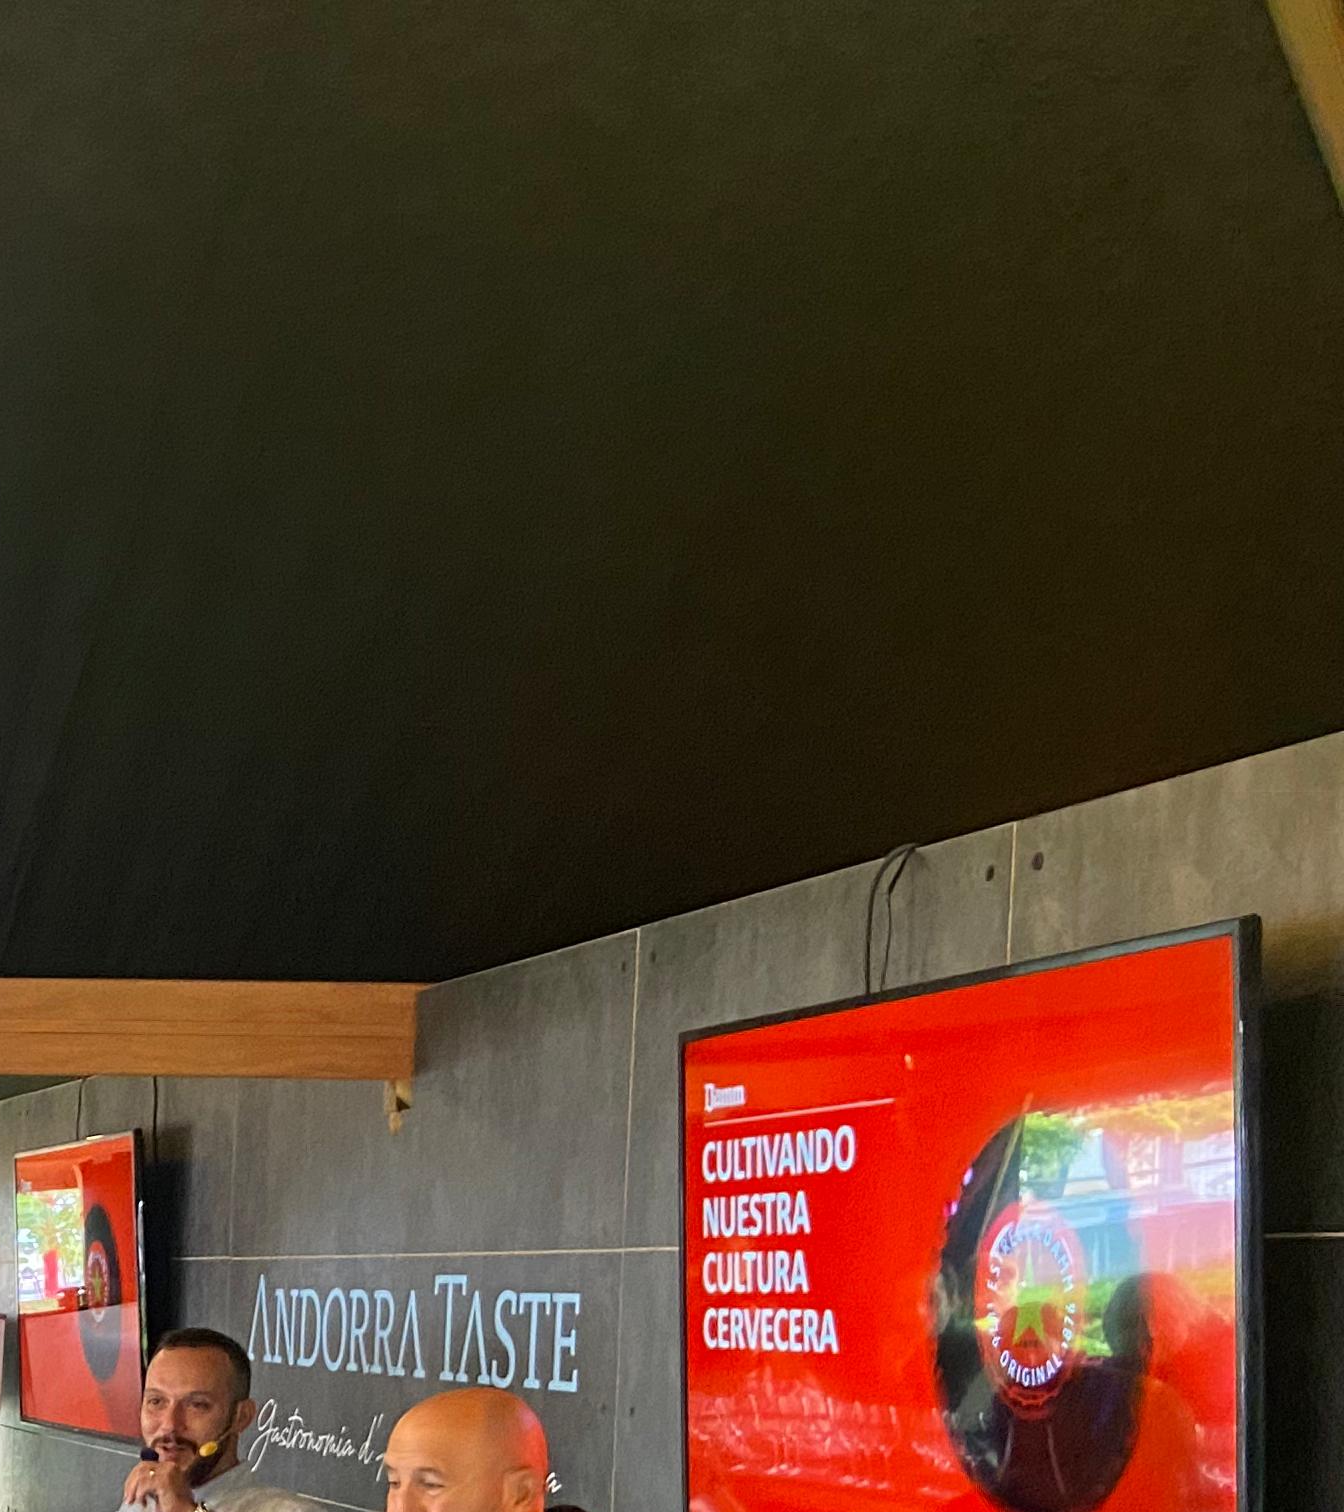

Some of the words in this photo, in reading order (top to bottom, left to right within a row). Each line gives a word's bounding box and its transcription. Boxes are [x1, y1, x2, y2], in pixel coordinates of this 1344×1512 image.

[702, 1125, 856, 1183] CULTIVANDO
[703, 1191, 811, 1239] NUESTRA
[703, 1250, 809, 1294] CULTURA
[703, 1307, 840, 1354] CERVECERA
[999, 1350, 1063, 1387] ORIGINAL
